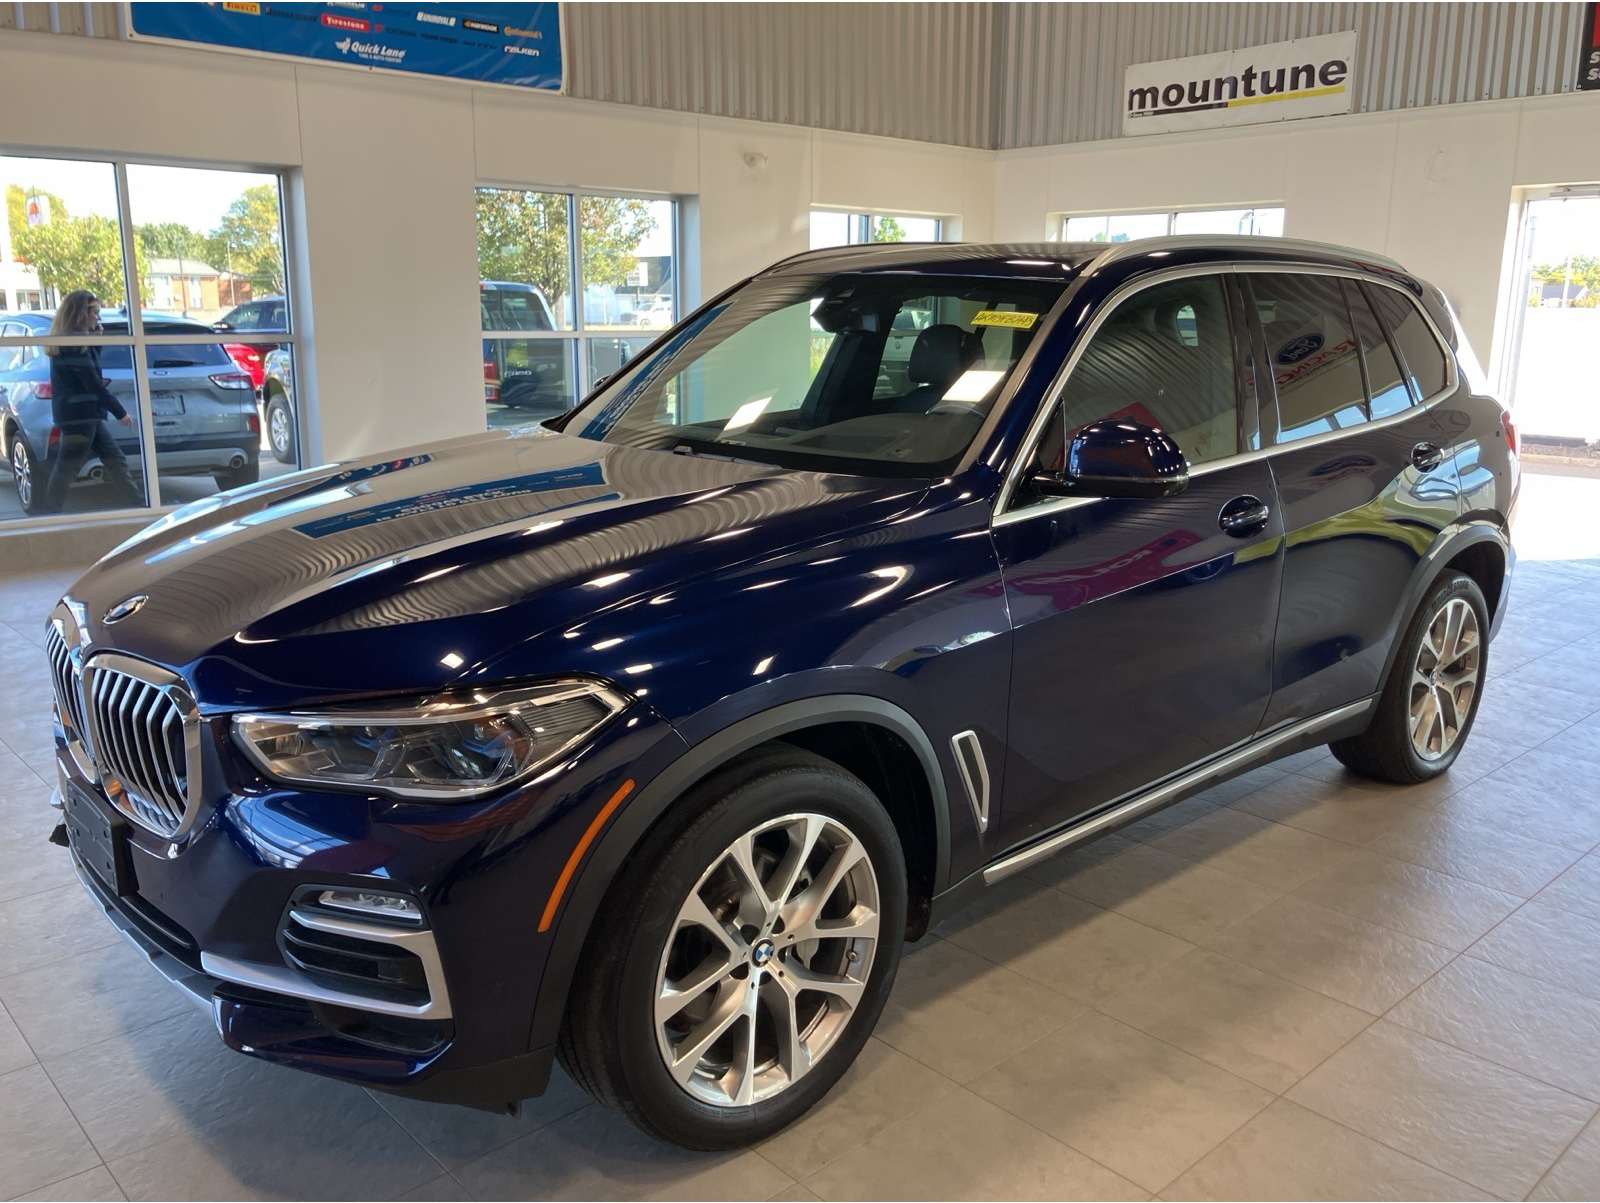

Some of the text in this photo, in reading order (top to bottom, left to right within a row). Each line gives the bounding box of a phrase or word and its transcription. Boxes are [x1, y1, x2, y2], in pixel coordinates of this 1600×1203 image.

[351, 40, 380, 54] Quick
[381, 45, 406, 58] Lane
[1127, 59, 1348, 112] mountune
